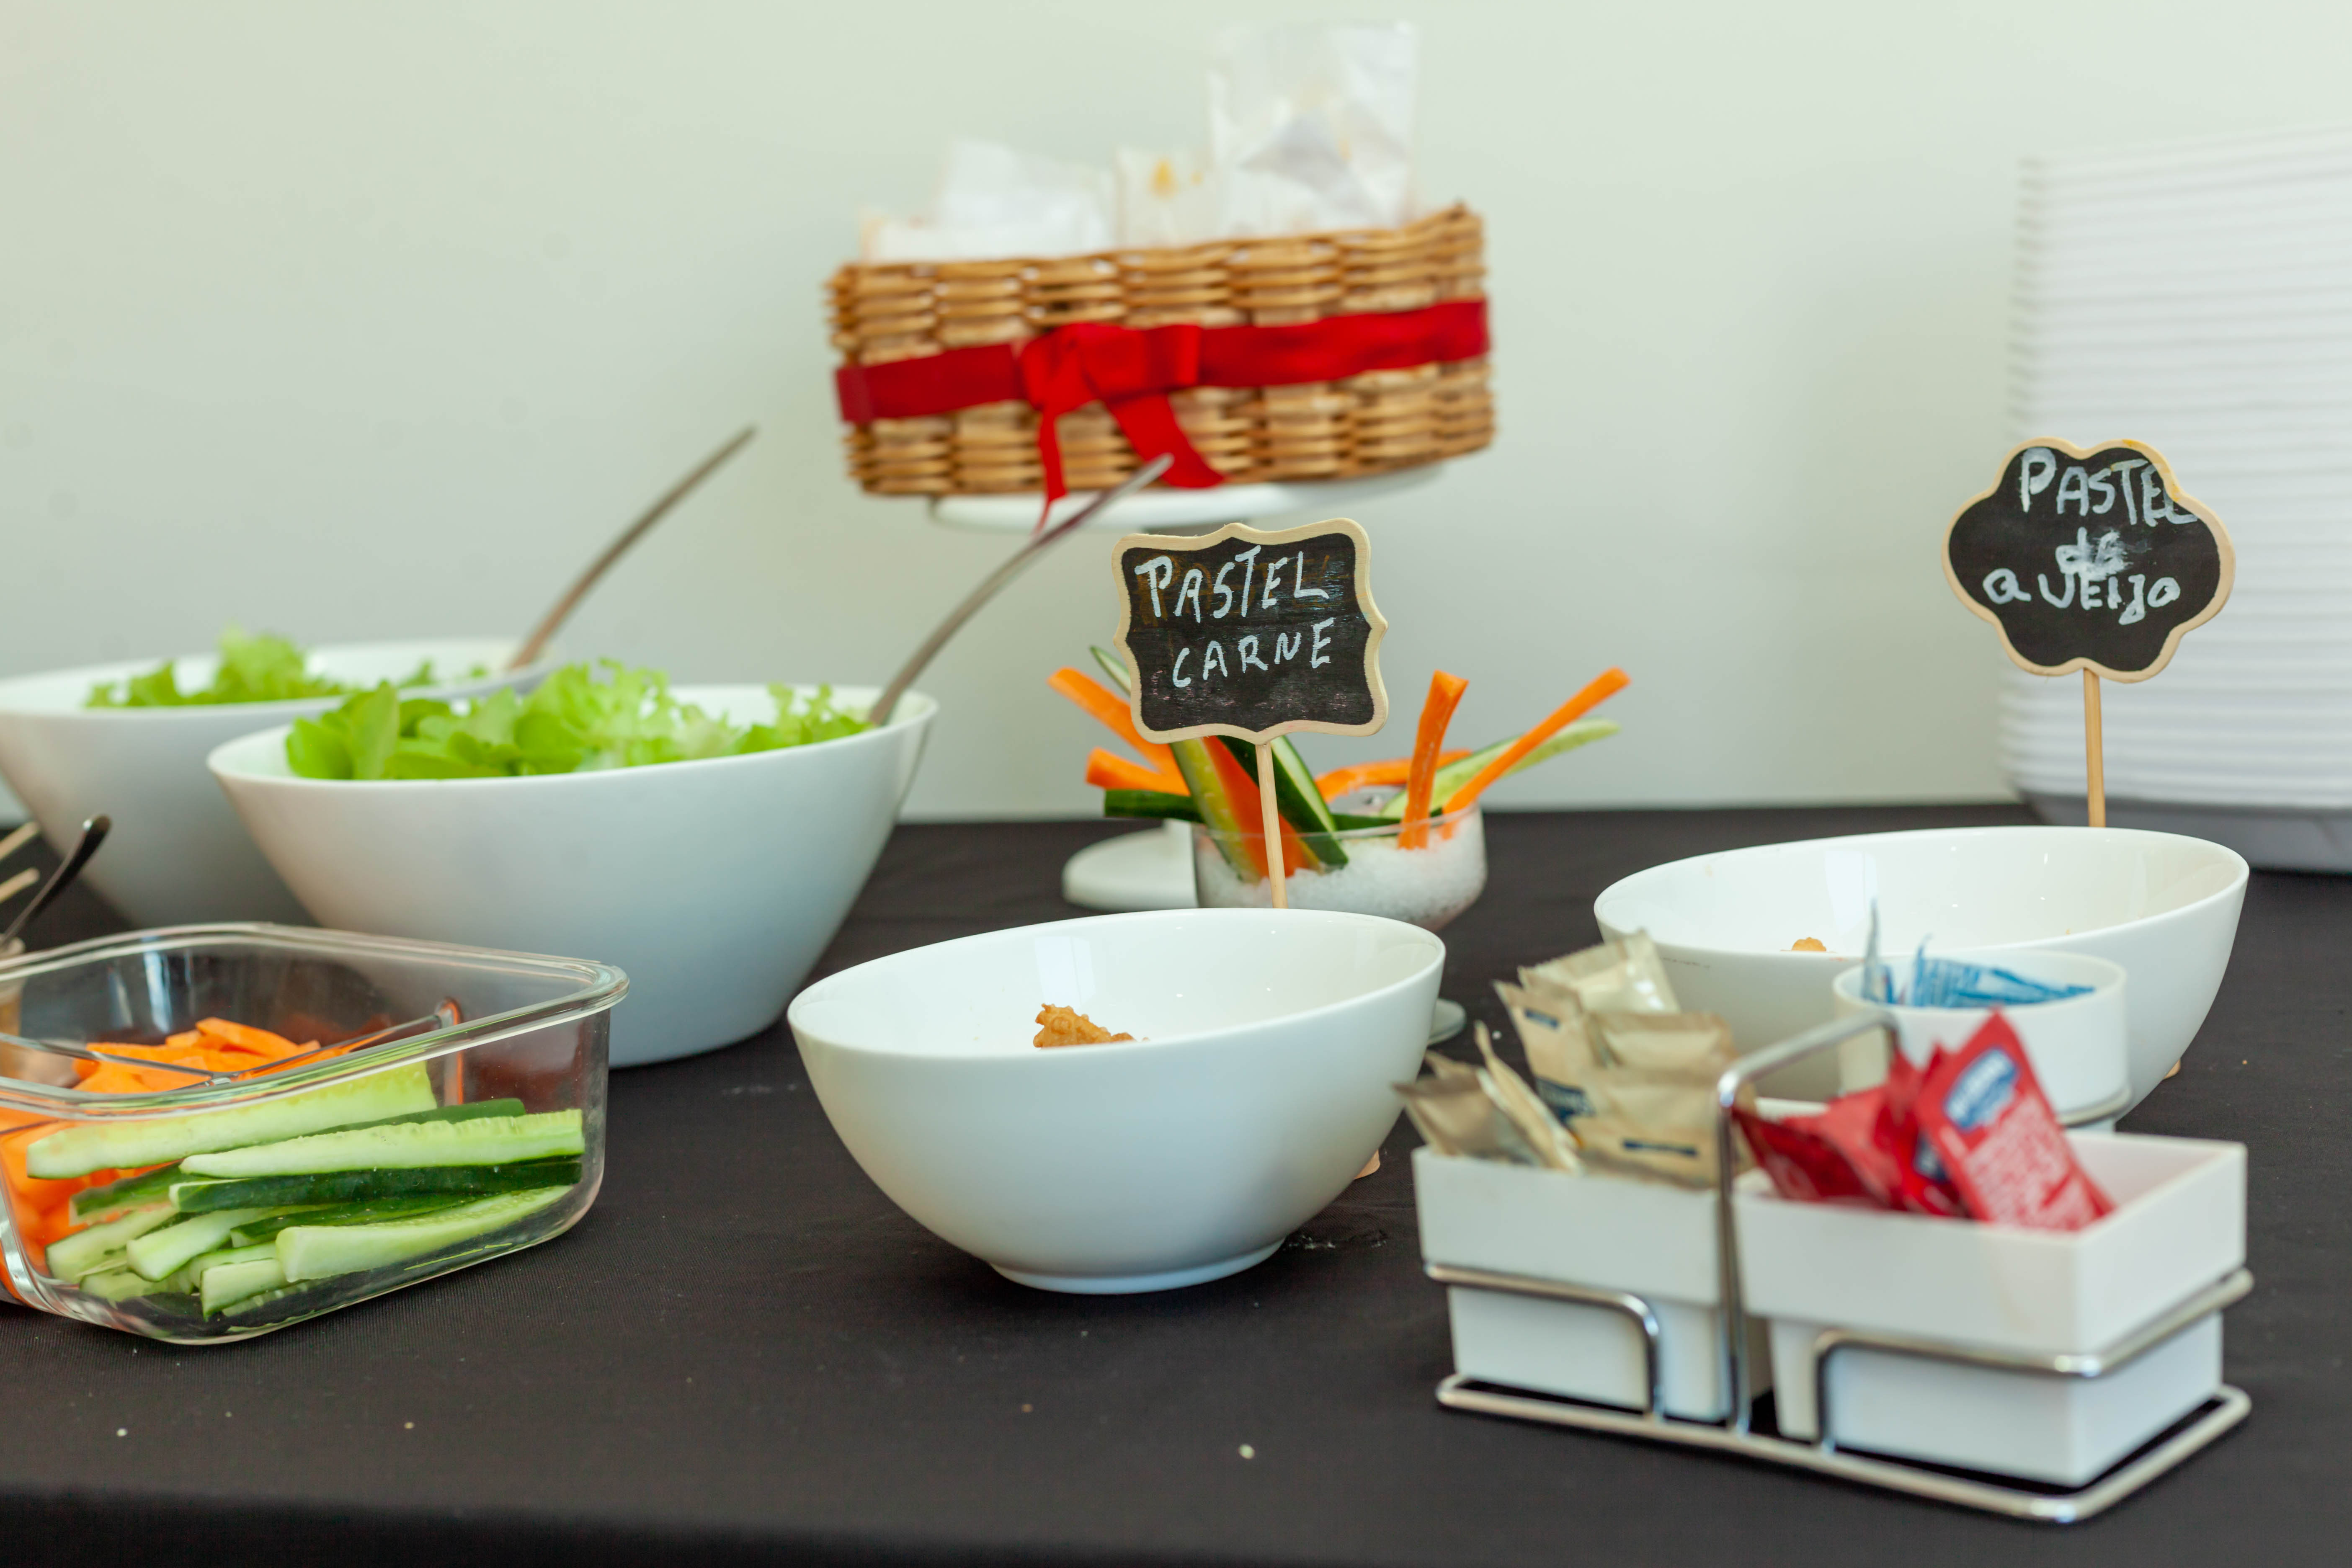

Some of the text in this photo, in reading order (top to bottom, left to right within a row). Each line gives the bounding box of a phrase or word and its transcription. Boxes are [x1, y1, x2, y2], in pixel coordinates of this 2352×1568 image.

[2019, 447, 2198, 527] PASTEL
[1135, 545, 1330, 623] PASTEL
[1173, 617, 1336, 688] CARNE
